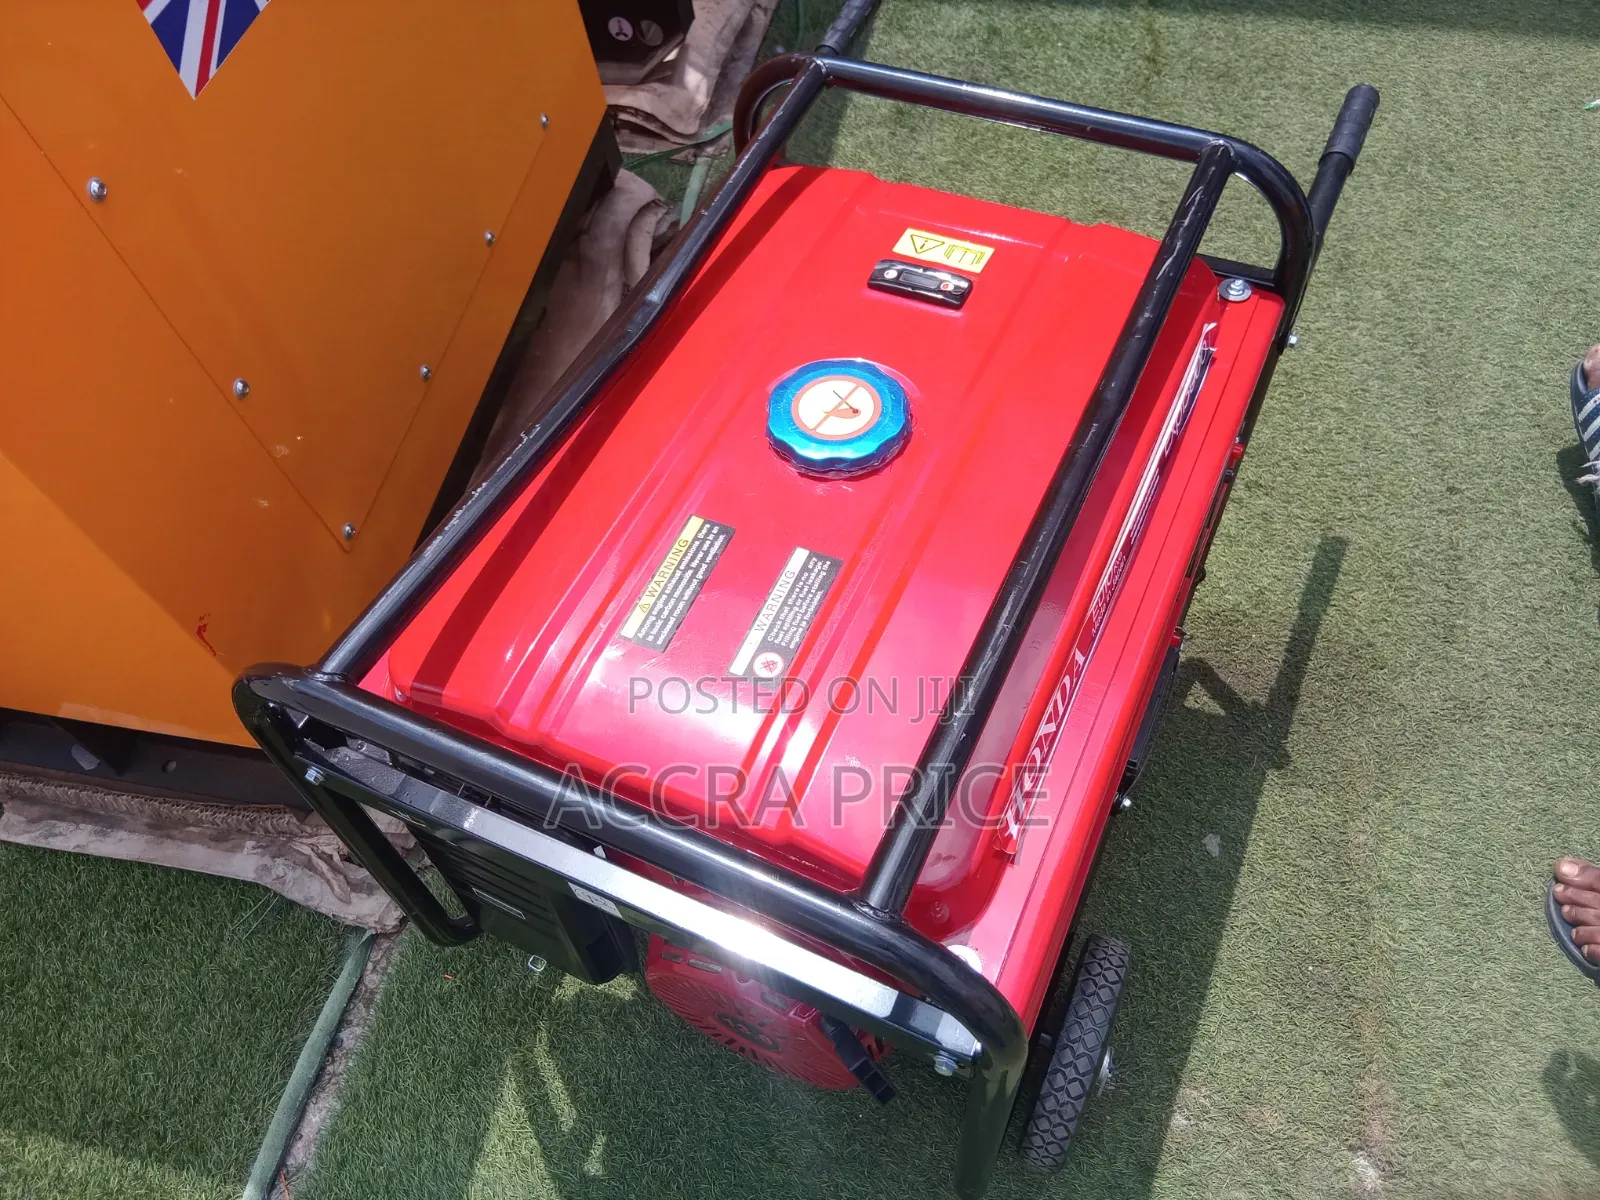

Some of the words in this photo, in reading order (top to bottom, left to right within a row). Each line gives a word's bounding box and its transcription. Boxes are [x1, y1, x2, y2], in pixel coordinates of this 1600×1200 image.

[637, 614, 656, 639] Among
[651, 593, 668, 615] engine
[664, 569, 682, 594] exhaust
[678, 537, 702, 570] emissions,
[697, 523, 710, 538] there
[646, 538, 689, 598] WARNING
[650, 618, 663, 635] toxic
[660, 597, 676, 619] carbon
[673, 567, 694, 597] monoxide.
[690, 550, 704, 567] Never
[702, 540, 711, 551] use
[712, 525, 719, 533] an
[656, 616, 676, 645] enclosed
[673, 600, 685, 616] room
[682, 577, 699, 600] without
[695, 563, 709, 579] good
[704, 533, 726, 563] ventilation.
[755, 569, 795, 632] WARNING
[767, 620, 782, 641] Check
[779, 606, 790, 620] that
[787, 587, 800, 604] there
[801, 572, 809, 580] no
[808, 557, 818, 569] any
[781, 626, 796, 646] Filling
[792, 613, 802, 626] fuel
[799, 592, 813, 613] before
[821, 560, 831, 570] the
[1092, 603, 1107, 637] Made
[1112, 555, 1127, 591] Japan
[775, 631, 785, 644] fuel
[796, 598, 802, 606] or
[799, 585, 809, 597] fuel
[788, 627, 804, 649] engine
[1005, 647, 1088, 840] HONDA
